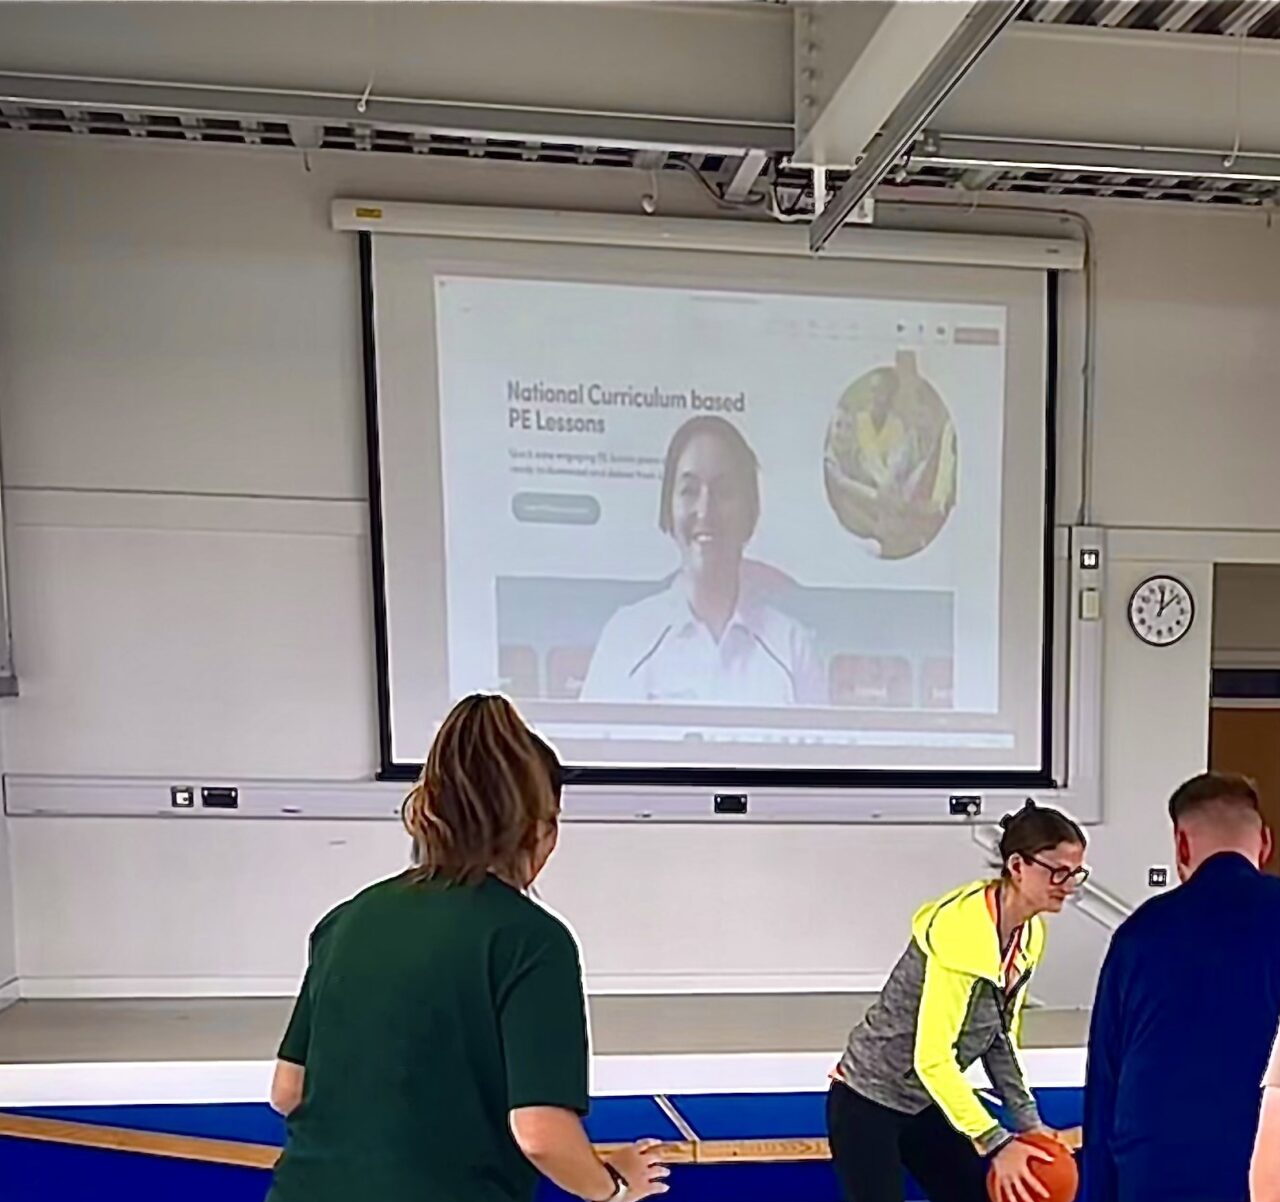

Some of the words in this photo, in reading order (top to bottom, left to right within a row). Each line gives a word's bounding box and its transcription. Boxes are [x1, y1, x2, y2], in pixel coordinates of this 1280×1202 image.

[507, 380, 584, 404] National
[587, 383, 687, 409] Curriculum
[691, 388, 746, 412] based
[508, 408, 532, 430] PE
[535, 409, 606, 434] Lessons
